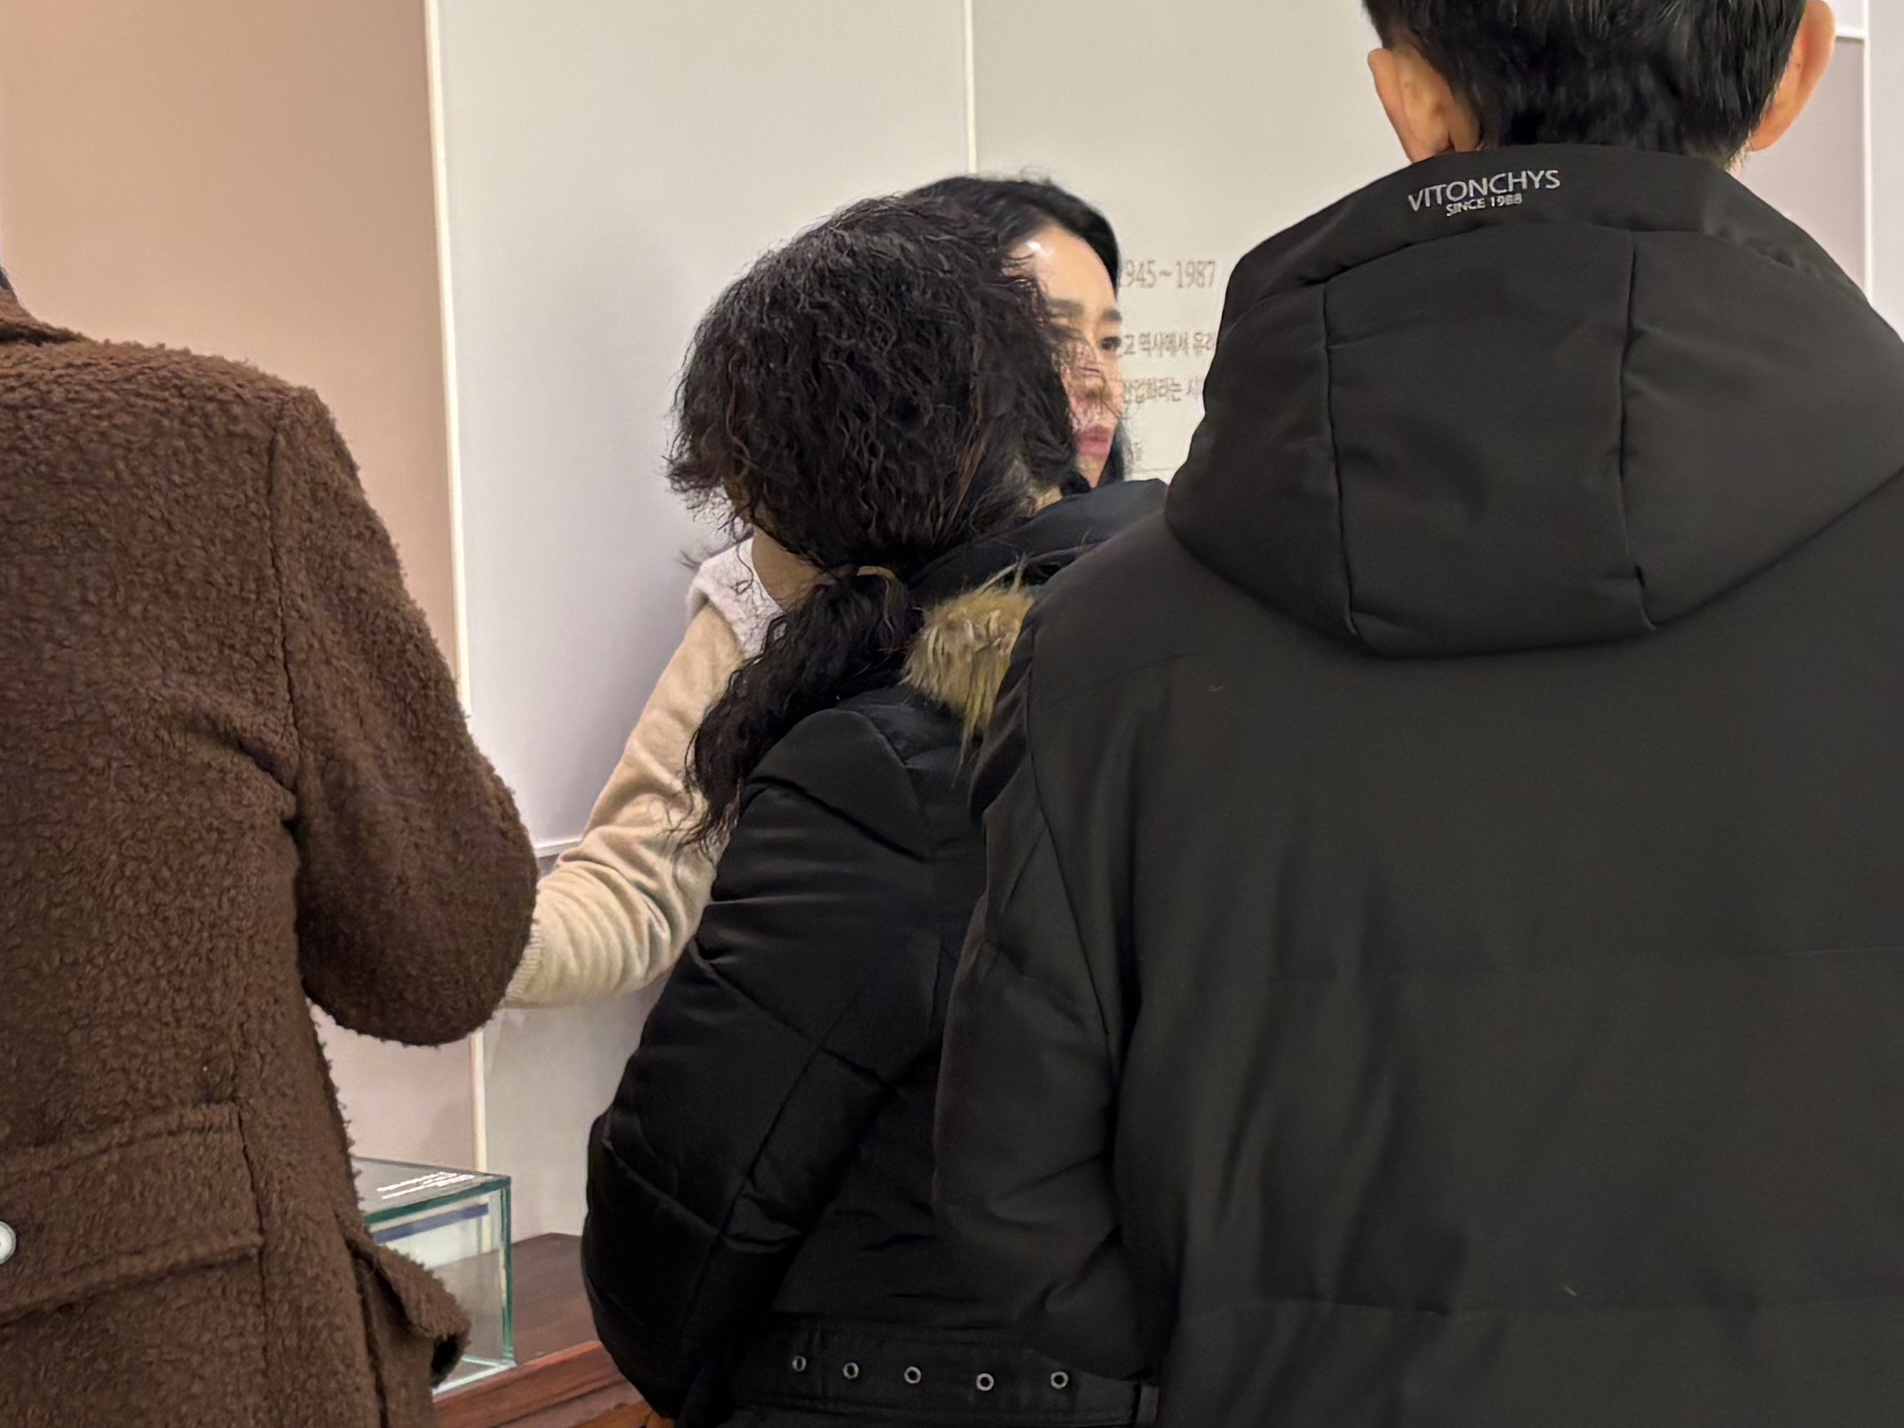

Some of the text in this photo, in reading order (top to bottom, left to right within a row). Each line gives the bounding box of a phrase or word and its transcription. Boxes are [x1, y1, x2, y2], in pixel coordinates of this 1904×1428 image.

[1408, 169, 1562, 212] VITONCHYS
[1445, 197, 1486, 217] SINCE
[1119, 259, 1216, 289] 945~1987
[1138, 331, 1189, 358] 역사에서
